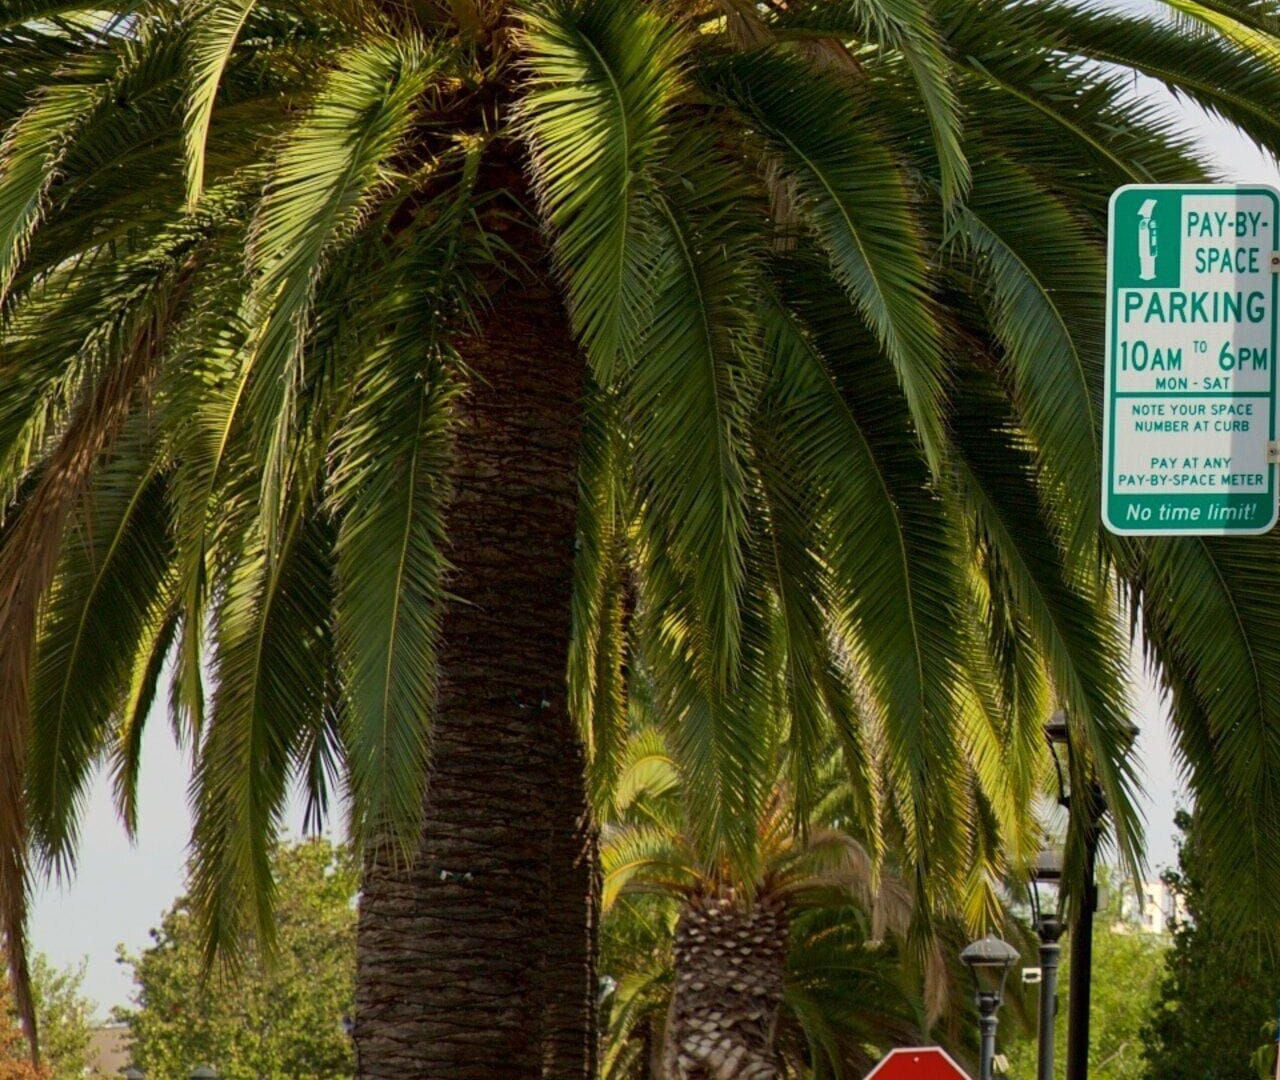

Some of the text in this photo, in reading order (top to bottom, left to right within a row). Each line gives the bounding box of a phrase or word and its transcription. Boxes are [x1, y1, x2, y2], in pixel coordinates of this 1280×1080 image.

[1187, 211, 1268, 237] PAY-BY-
[1195, 248, 1259, 272] SPACE
[1124, 291, 1265, 322] PARKING
[1121, 340, 1267, 370] 10AM TO 6PM
[1155, 377, 1186, 390] MON
[1202, 377, 1230, 390] SAT
[1132, 404, 1252, 415] NOTE YOUR SPACE
[1135, 420, 1249, 431] NUMBER AT CURB
[1151, 457, 1231, 468] PAY AT ANY
[1118, 474, 1263, 485] PAY-BY-SPACE METER
[1126, 503, 1256, 520] No time limit!
